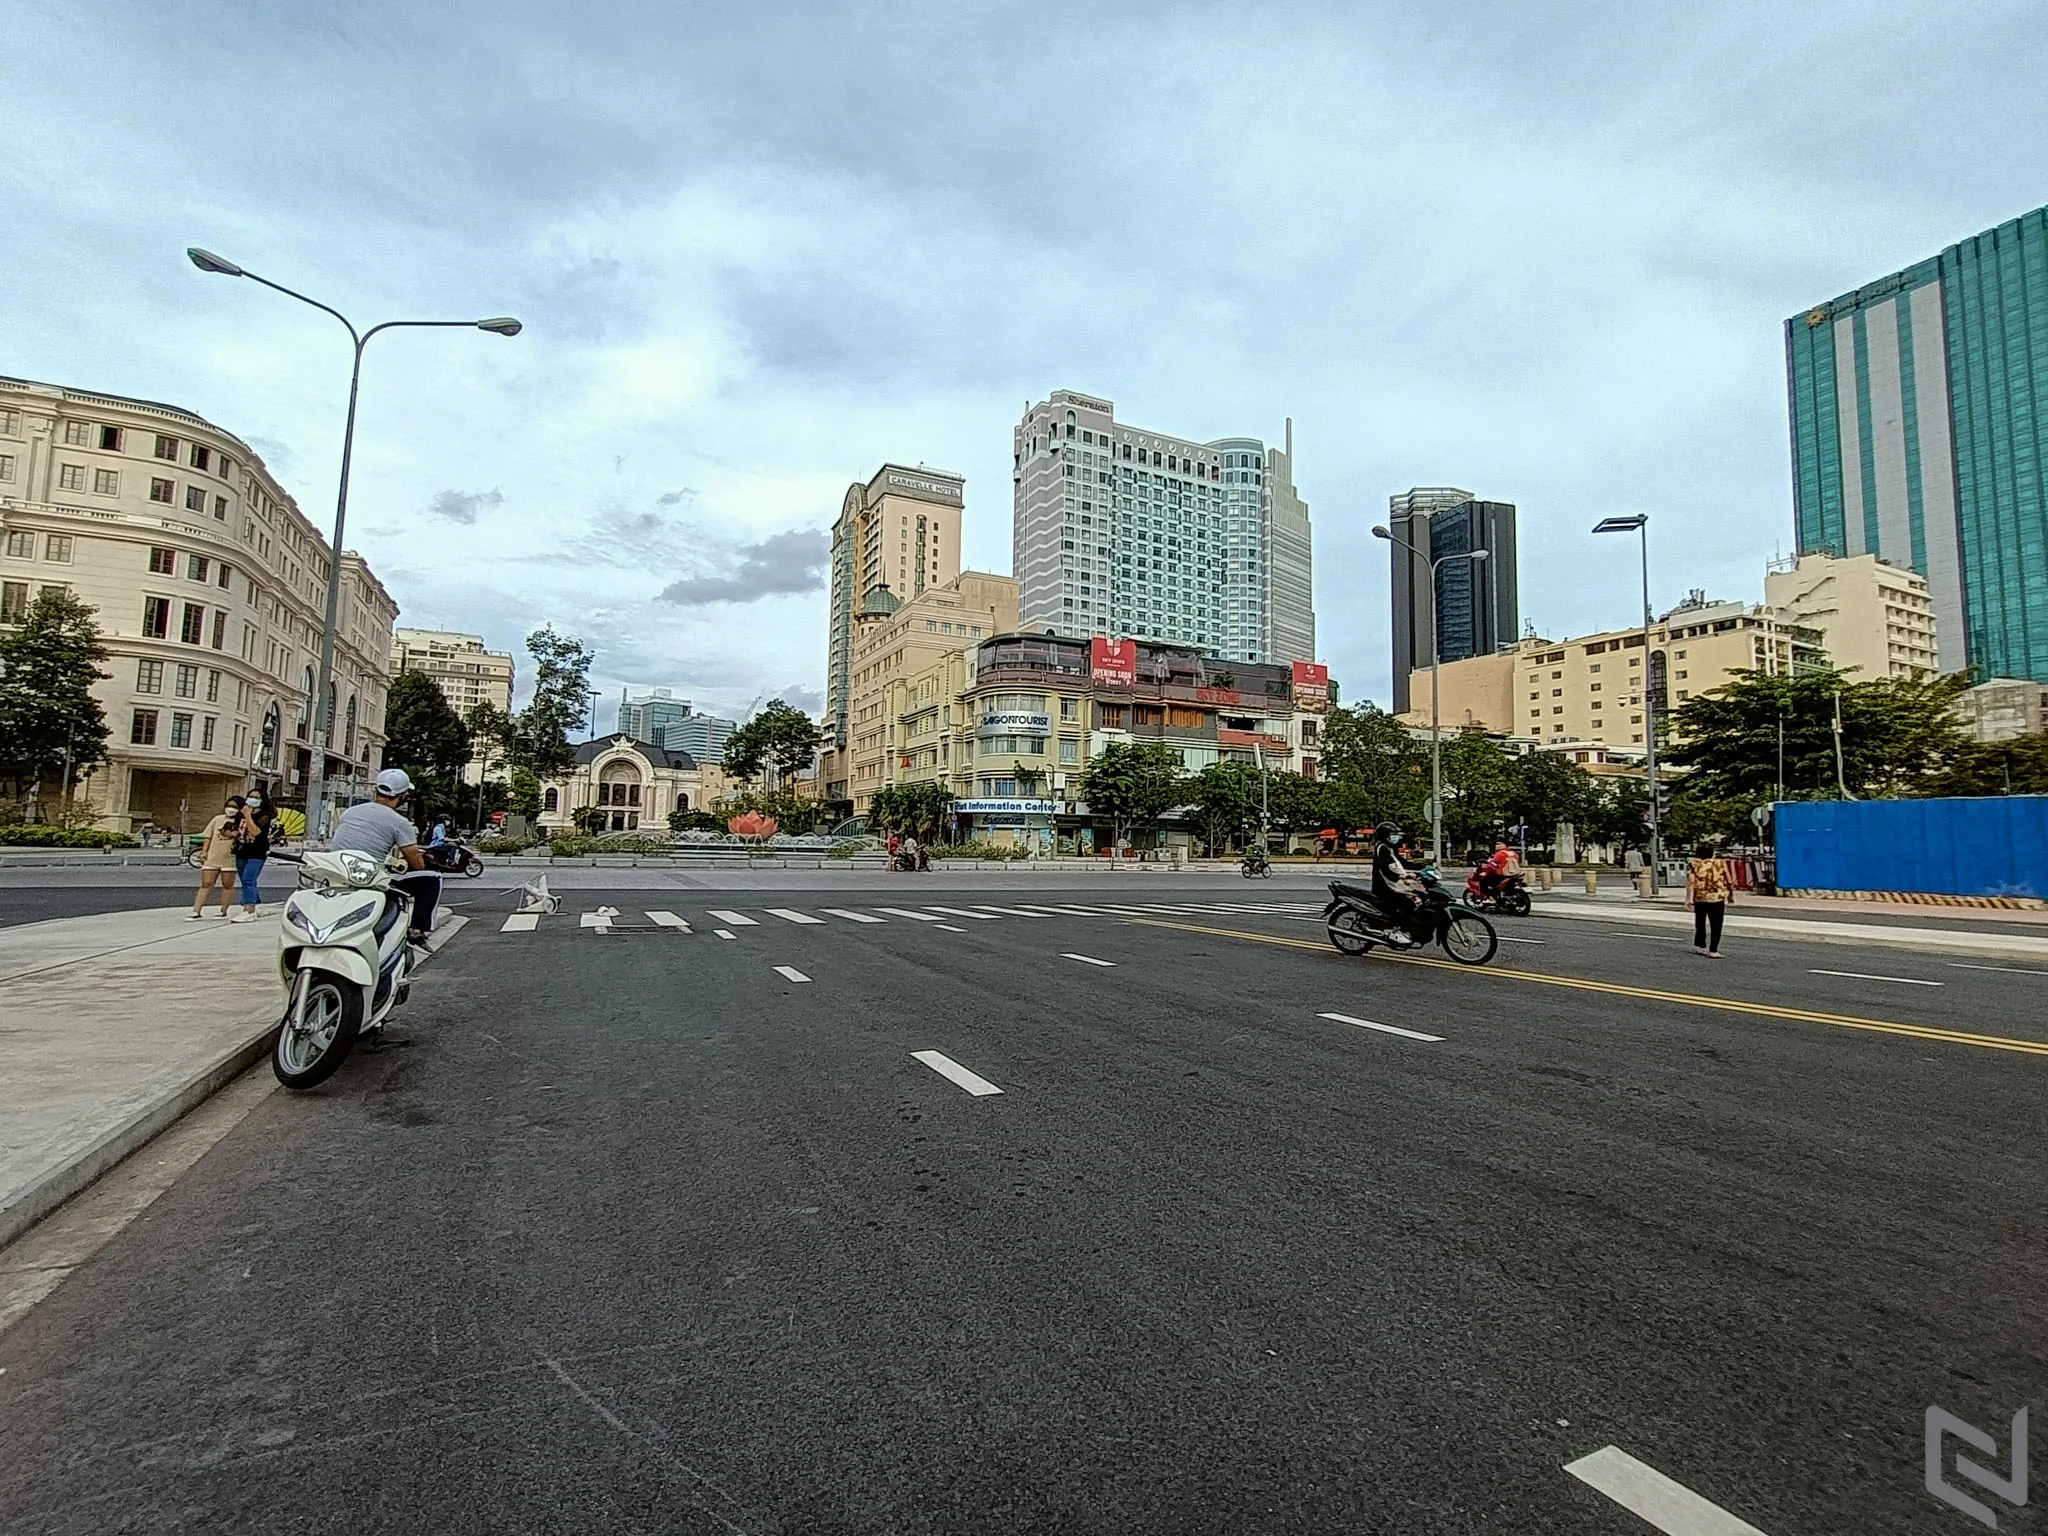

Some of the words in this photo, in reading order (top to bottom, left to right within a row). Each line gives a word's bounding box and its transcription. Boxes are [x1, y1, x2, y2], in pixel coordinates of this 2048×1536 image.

[1068, 395, 1109, 413] Sheraton
[891, 477, 933, 490] CARAVELLE
[935, 485, 958, 496] HOTEL
[969, 802, 1022, 810] Information
